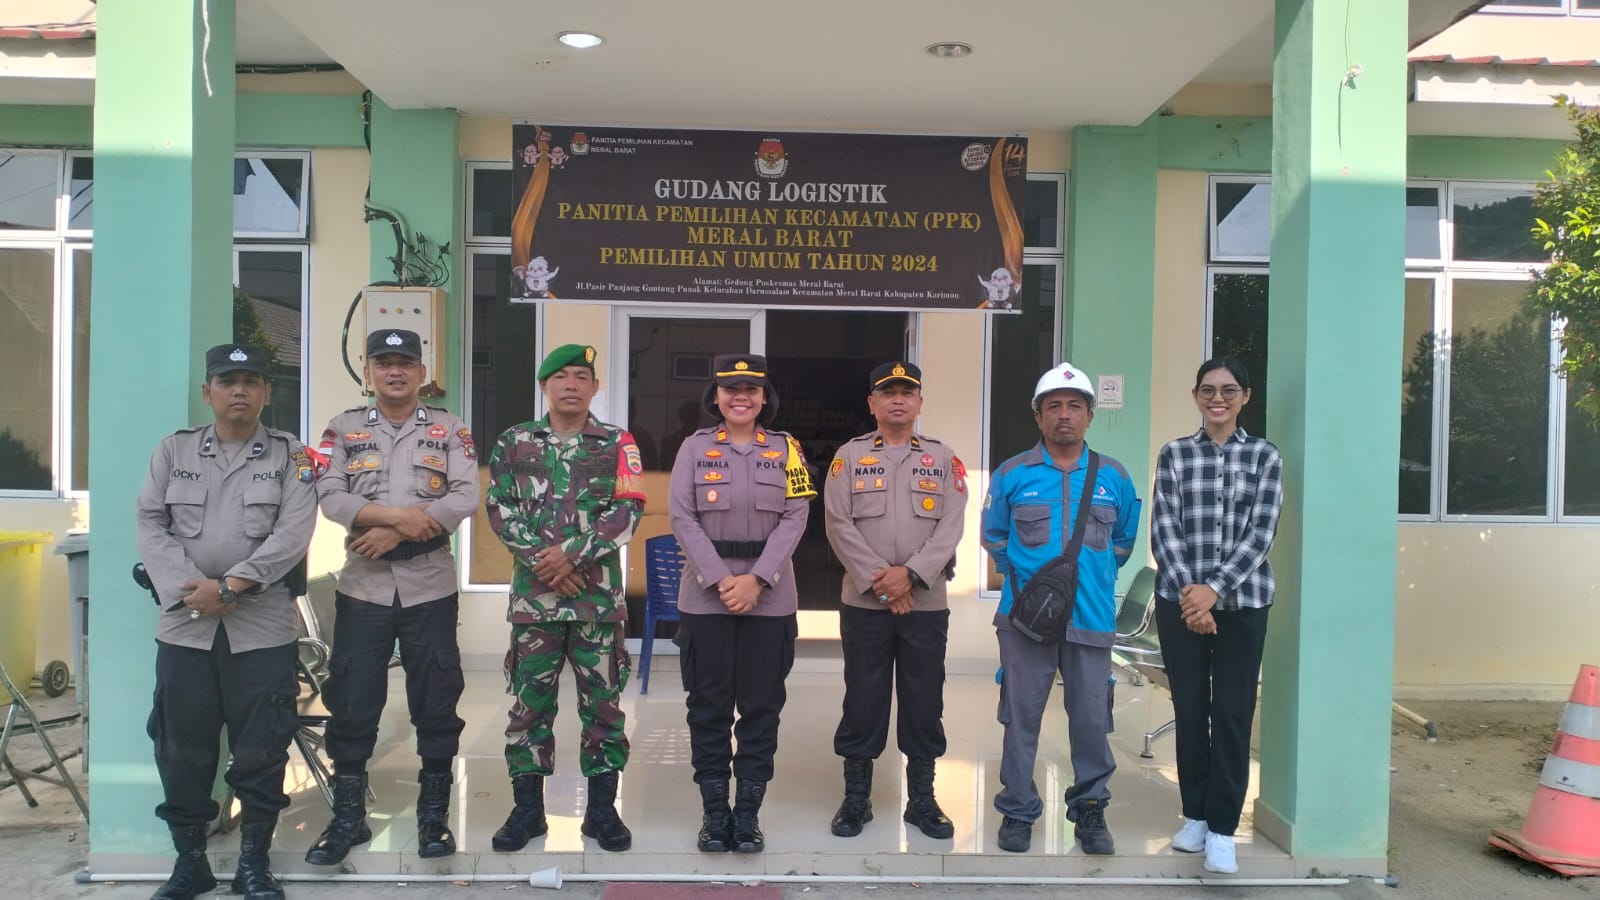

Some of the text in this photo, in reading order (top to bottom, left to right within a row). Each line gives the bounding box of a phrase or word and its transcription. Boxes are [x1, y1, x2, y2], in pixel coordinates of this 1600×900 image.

[654, 178, 888, 204] GUDANG LOGISTIK
[557, 202, 982, 232] PANITIA PEMILIHAN KECAMATAN (PPK)
[688, 226, 853, 248] MERAL BARAT
[600, 247, 938, 272] PEMILIHAN UMUM TAHUN 2024
[824, 280, 844, 288] Barat
[860, 289, 881, 297] Barat
[172, 468, 201, 481] OCKY
[854, 466, 885, 476] NANO
[912, 468, 943, 478] POLRI
